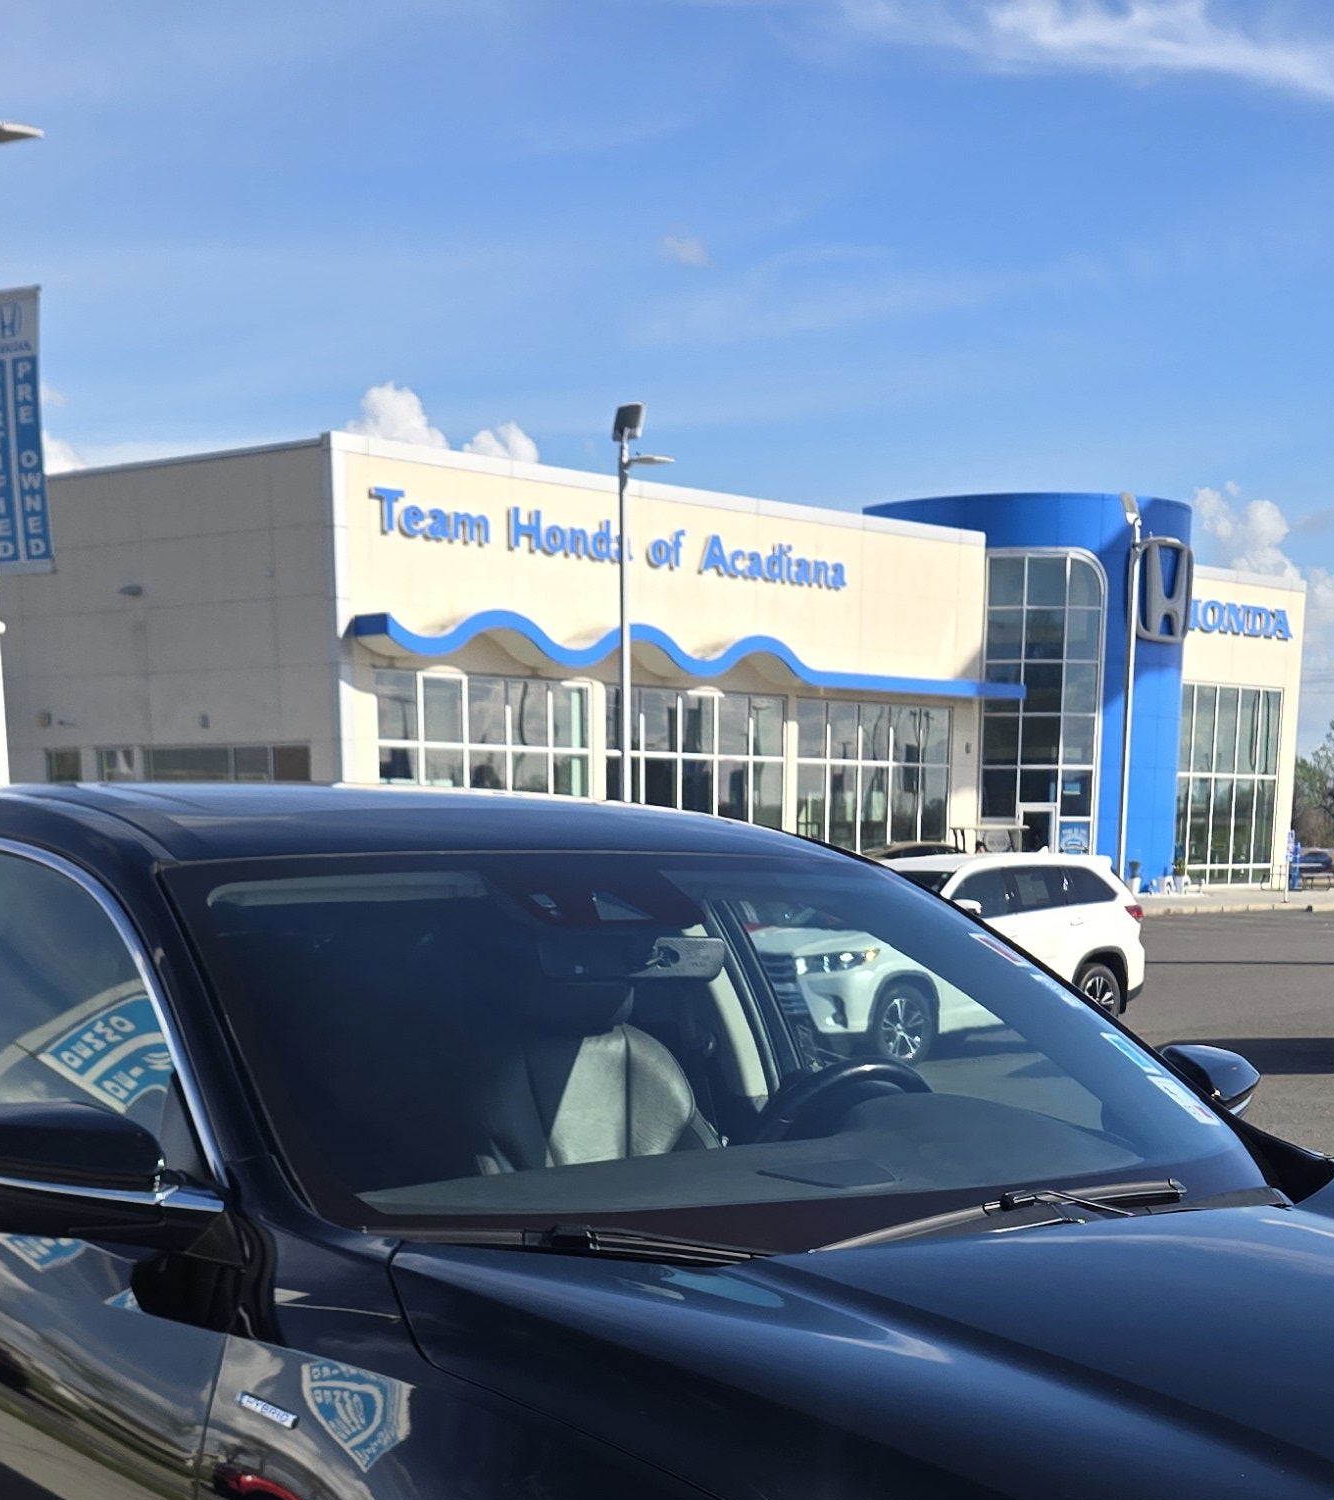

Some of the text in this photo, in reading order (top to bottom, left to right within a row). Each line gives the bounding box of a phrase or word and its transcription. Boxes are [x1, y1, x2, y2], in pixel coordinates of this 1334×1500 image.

[17, 361, 46, 556] PRE OWNED
[369, 486, 491, 546] Team
[646, 529, 687, 570] of
[698, 534, 848, 590] Acadiana
